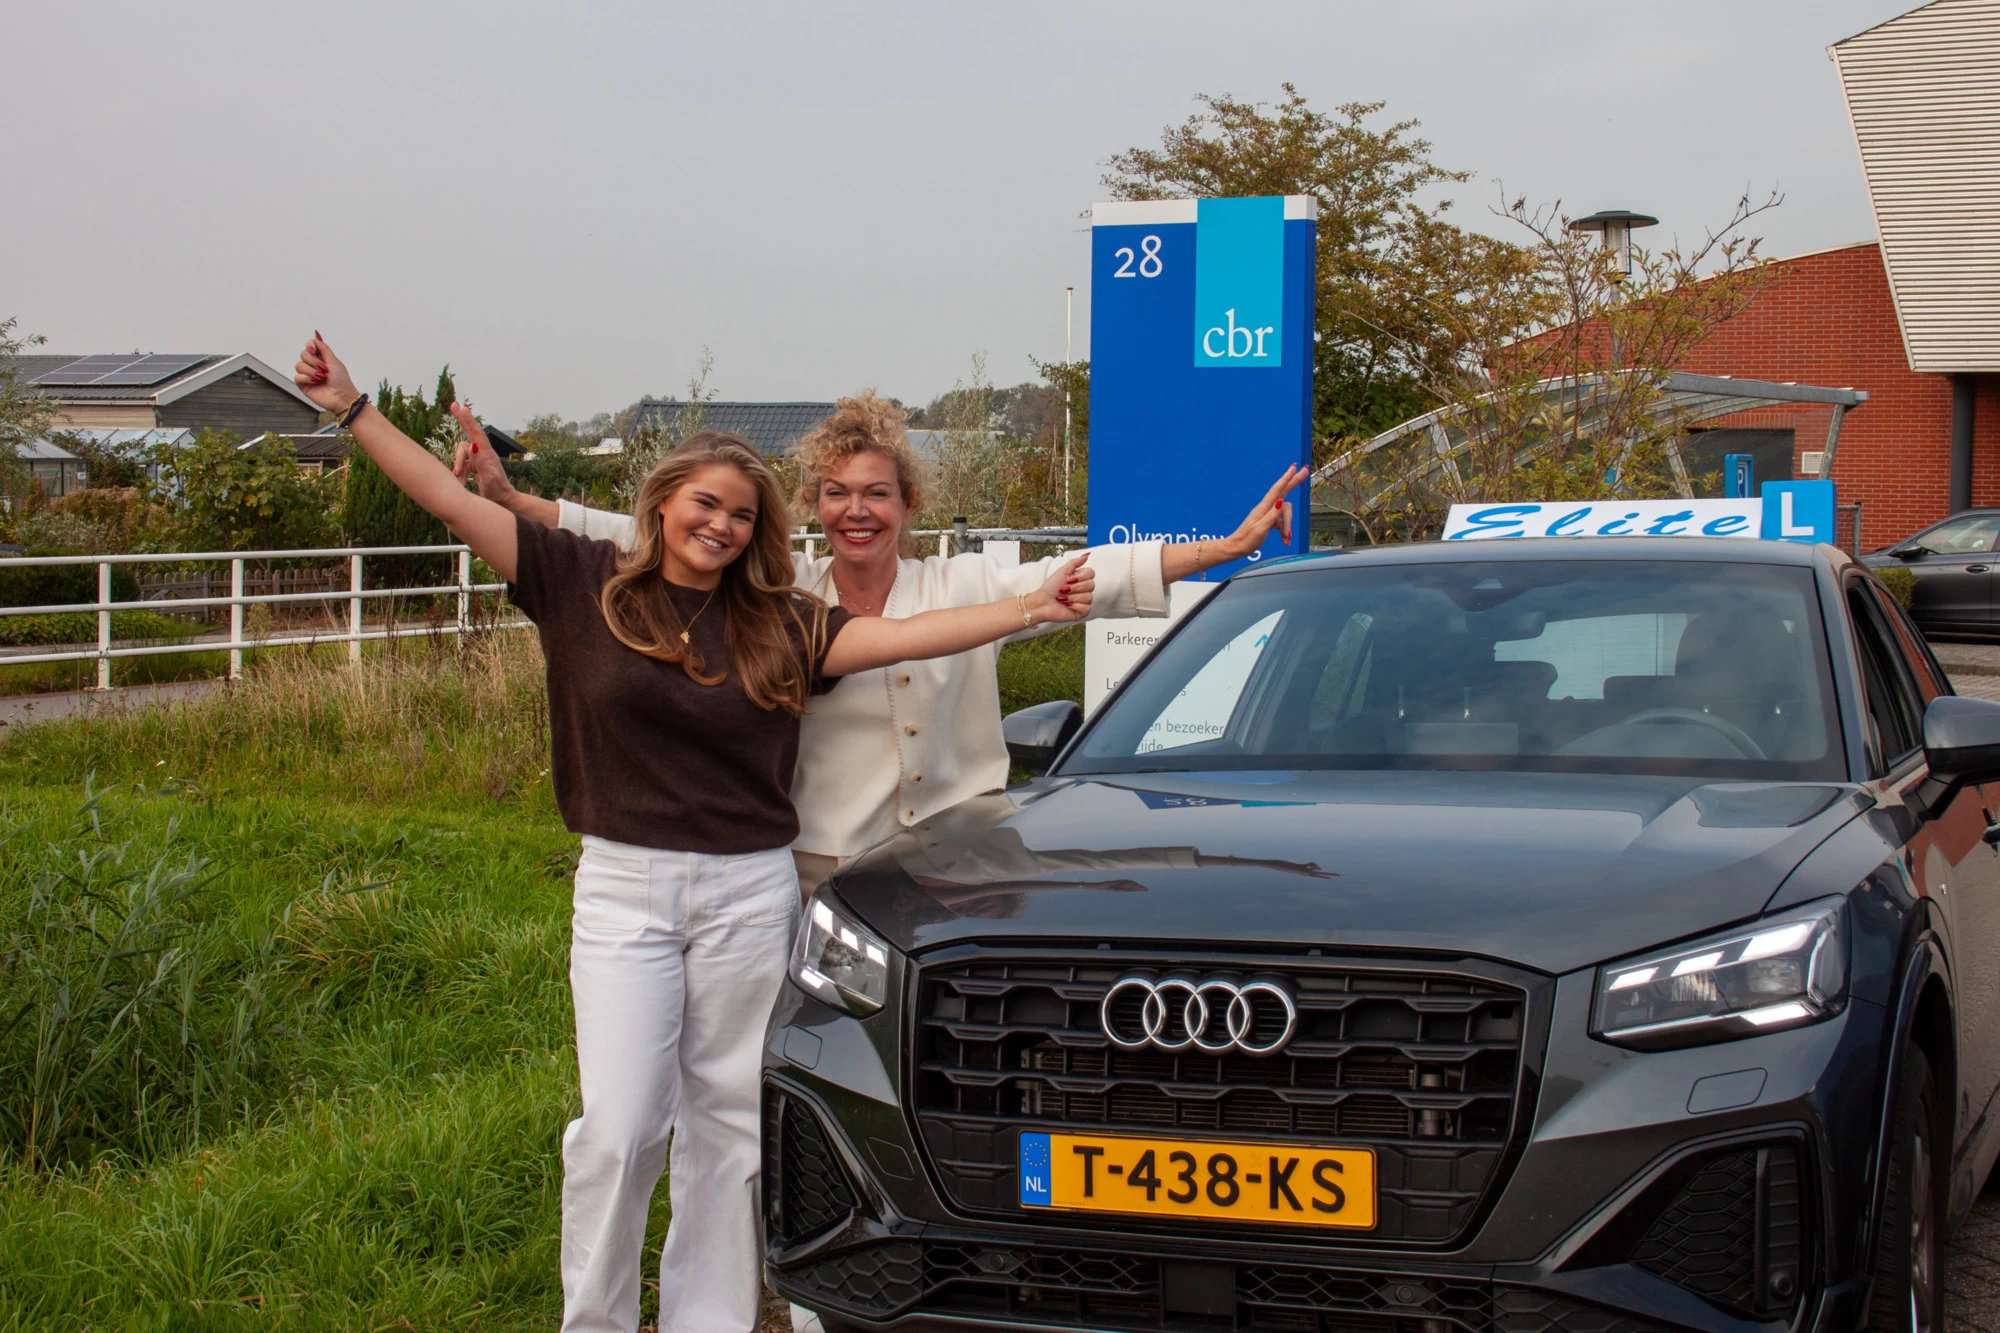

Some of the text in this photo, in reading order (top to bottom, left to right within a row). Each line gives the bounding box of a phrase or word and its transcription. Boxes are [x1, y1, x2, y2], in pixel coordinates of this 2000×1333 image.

[1113, 234, 1163, 278] 28
[1203, 307, 1274, 358] cbr
[1447, 504, 1750, 539] Elite
[1780, 491, 1815, 537] L
[1166, 719, 1225, 735] bezoeker
[1025, 1175, 1047, 1193] NL
[1072, 1144, 1346, 1214] T-438-KS
